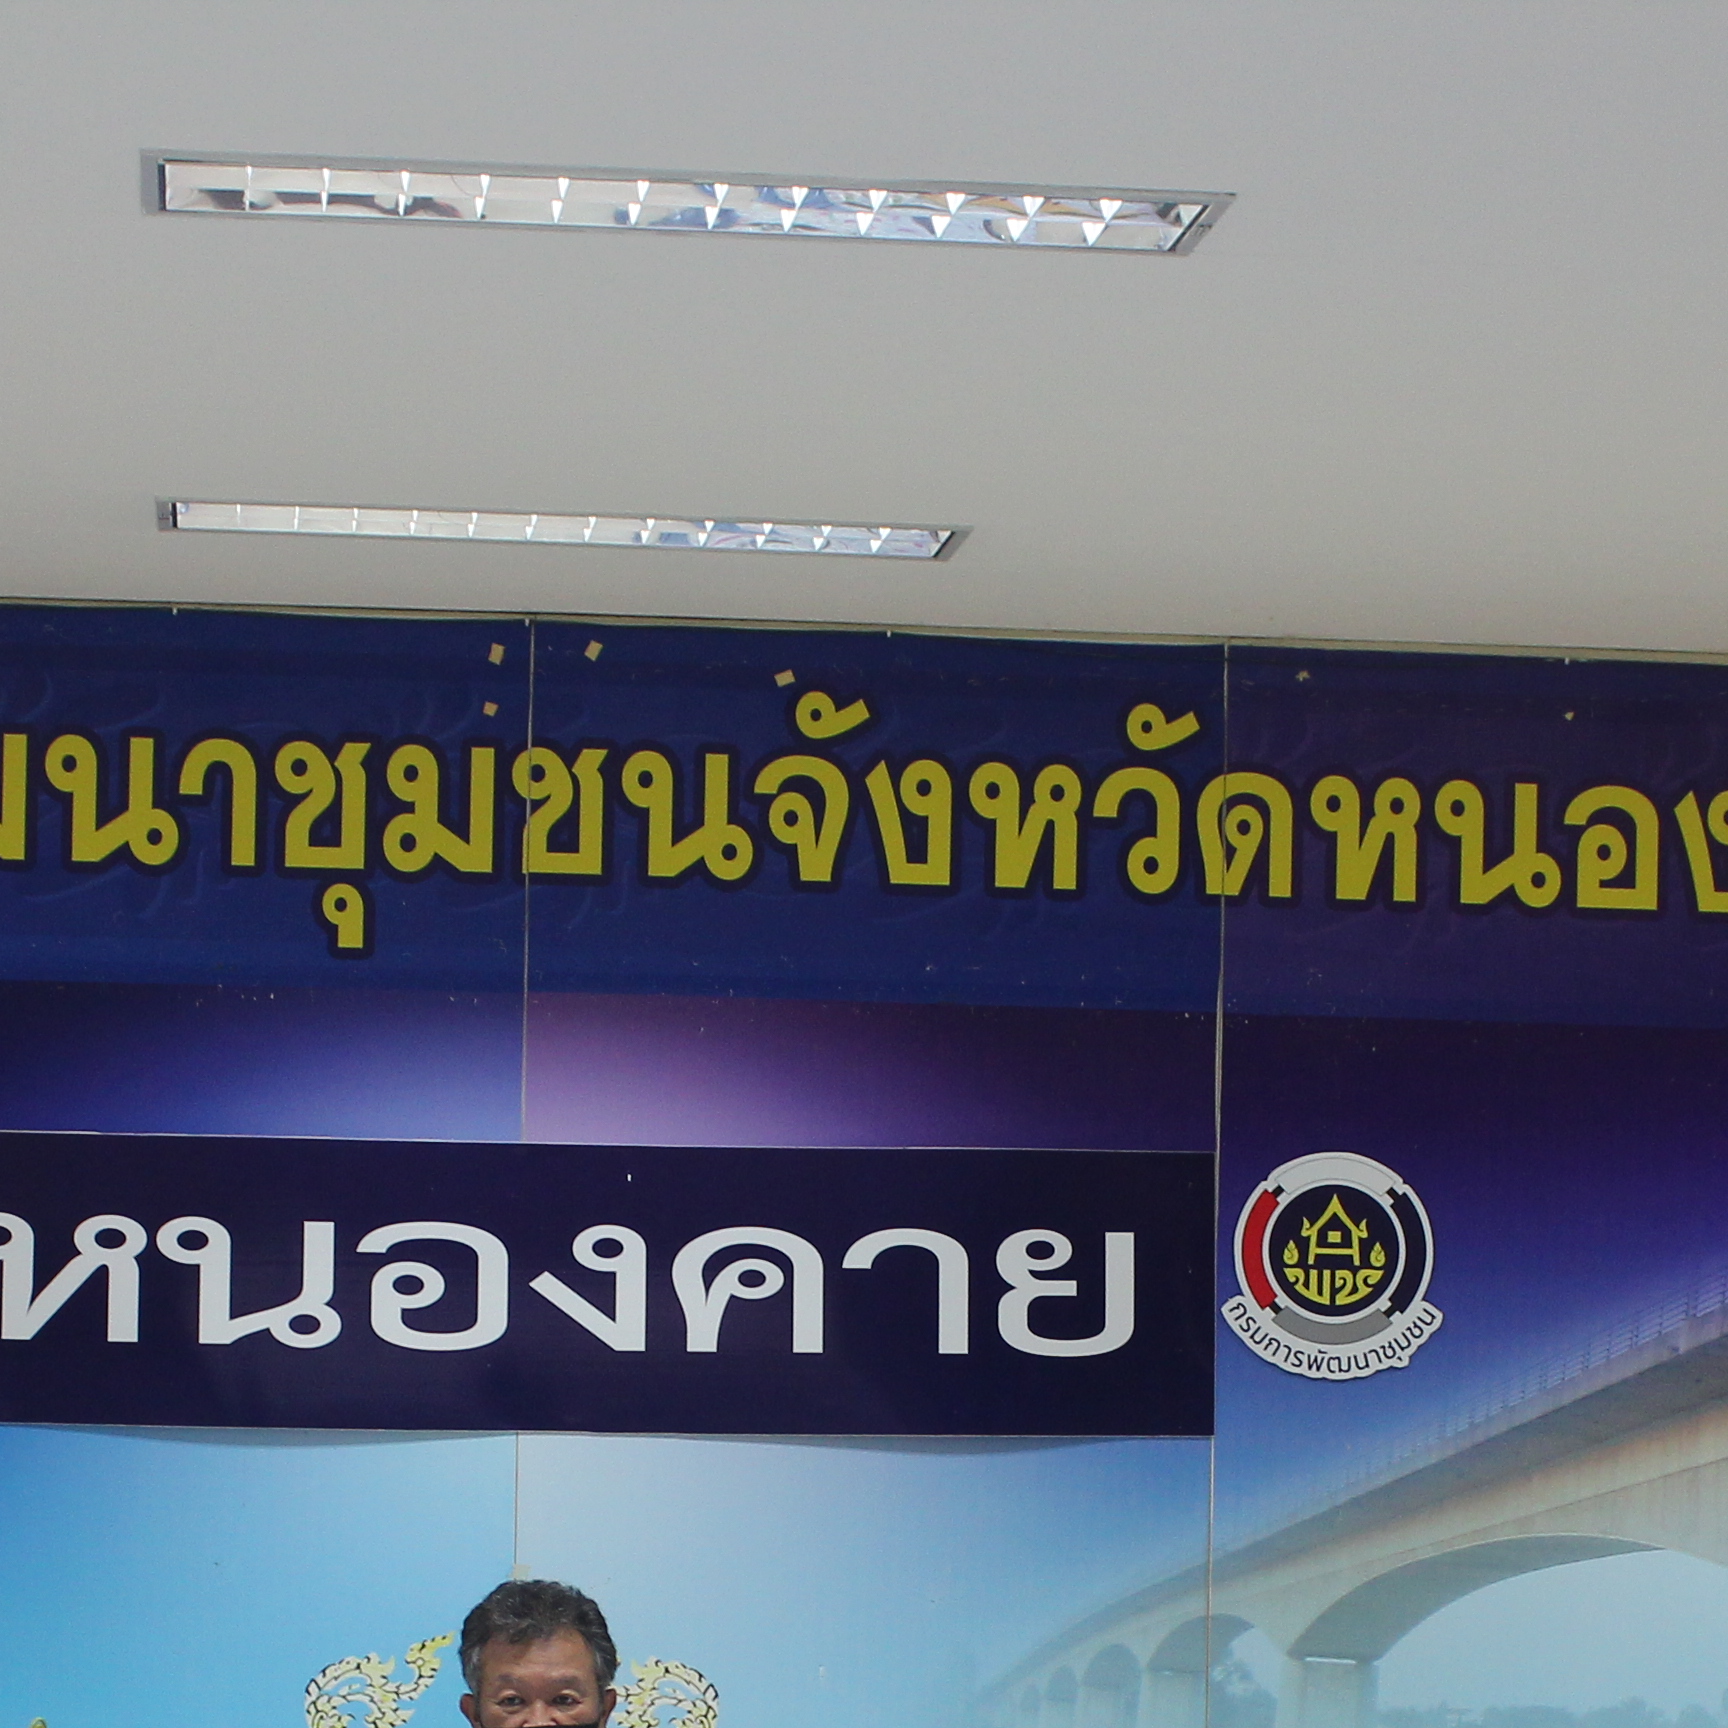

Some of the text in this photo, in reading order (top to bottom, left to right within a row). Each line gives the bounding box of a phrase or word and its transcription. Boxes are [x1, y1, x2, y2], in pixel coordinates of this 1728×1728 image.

[1228, 1302, 1438, 1374] กรมการพัฒนาชุมชน
